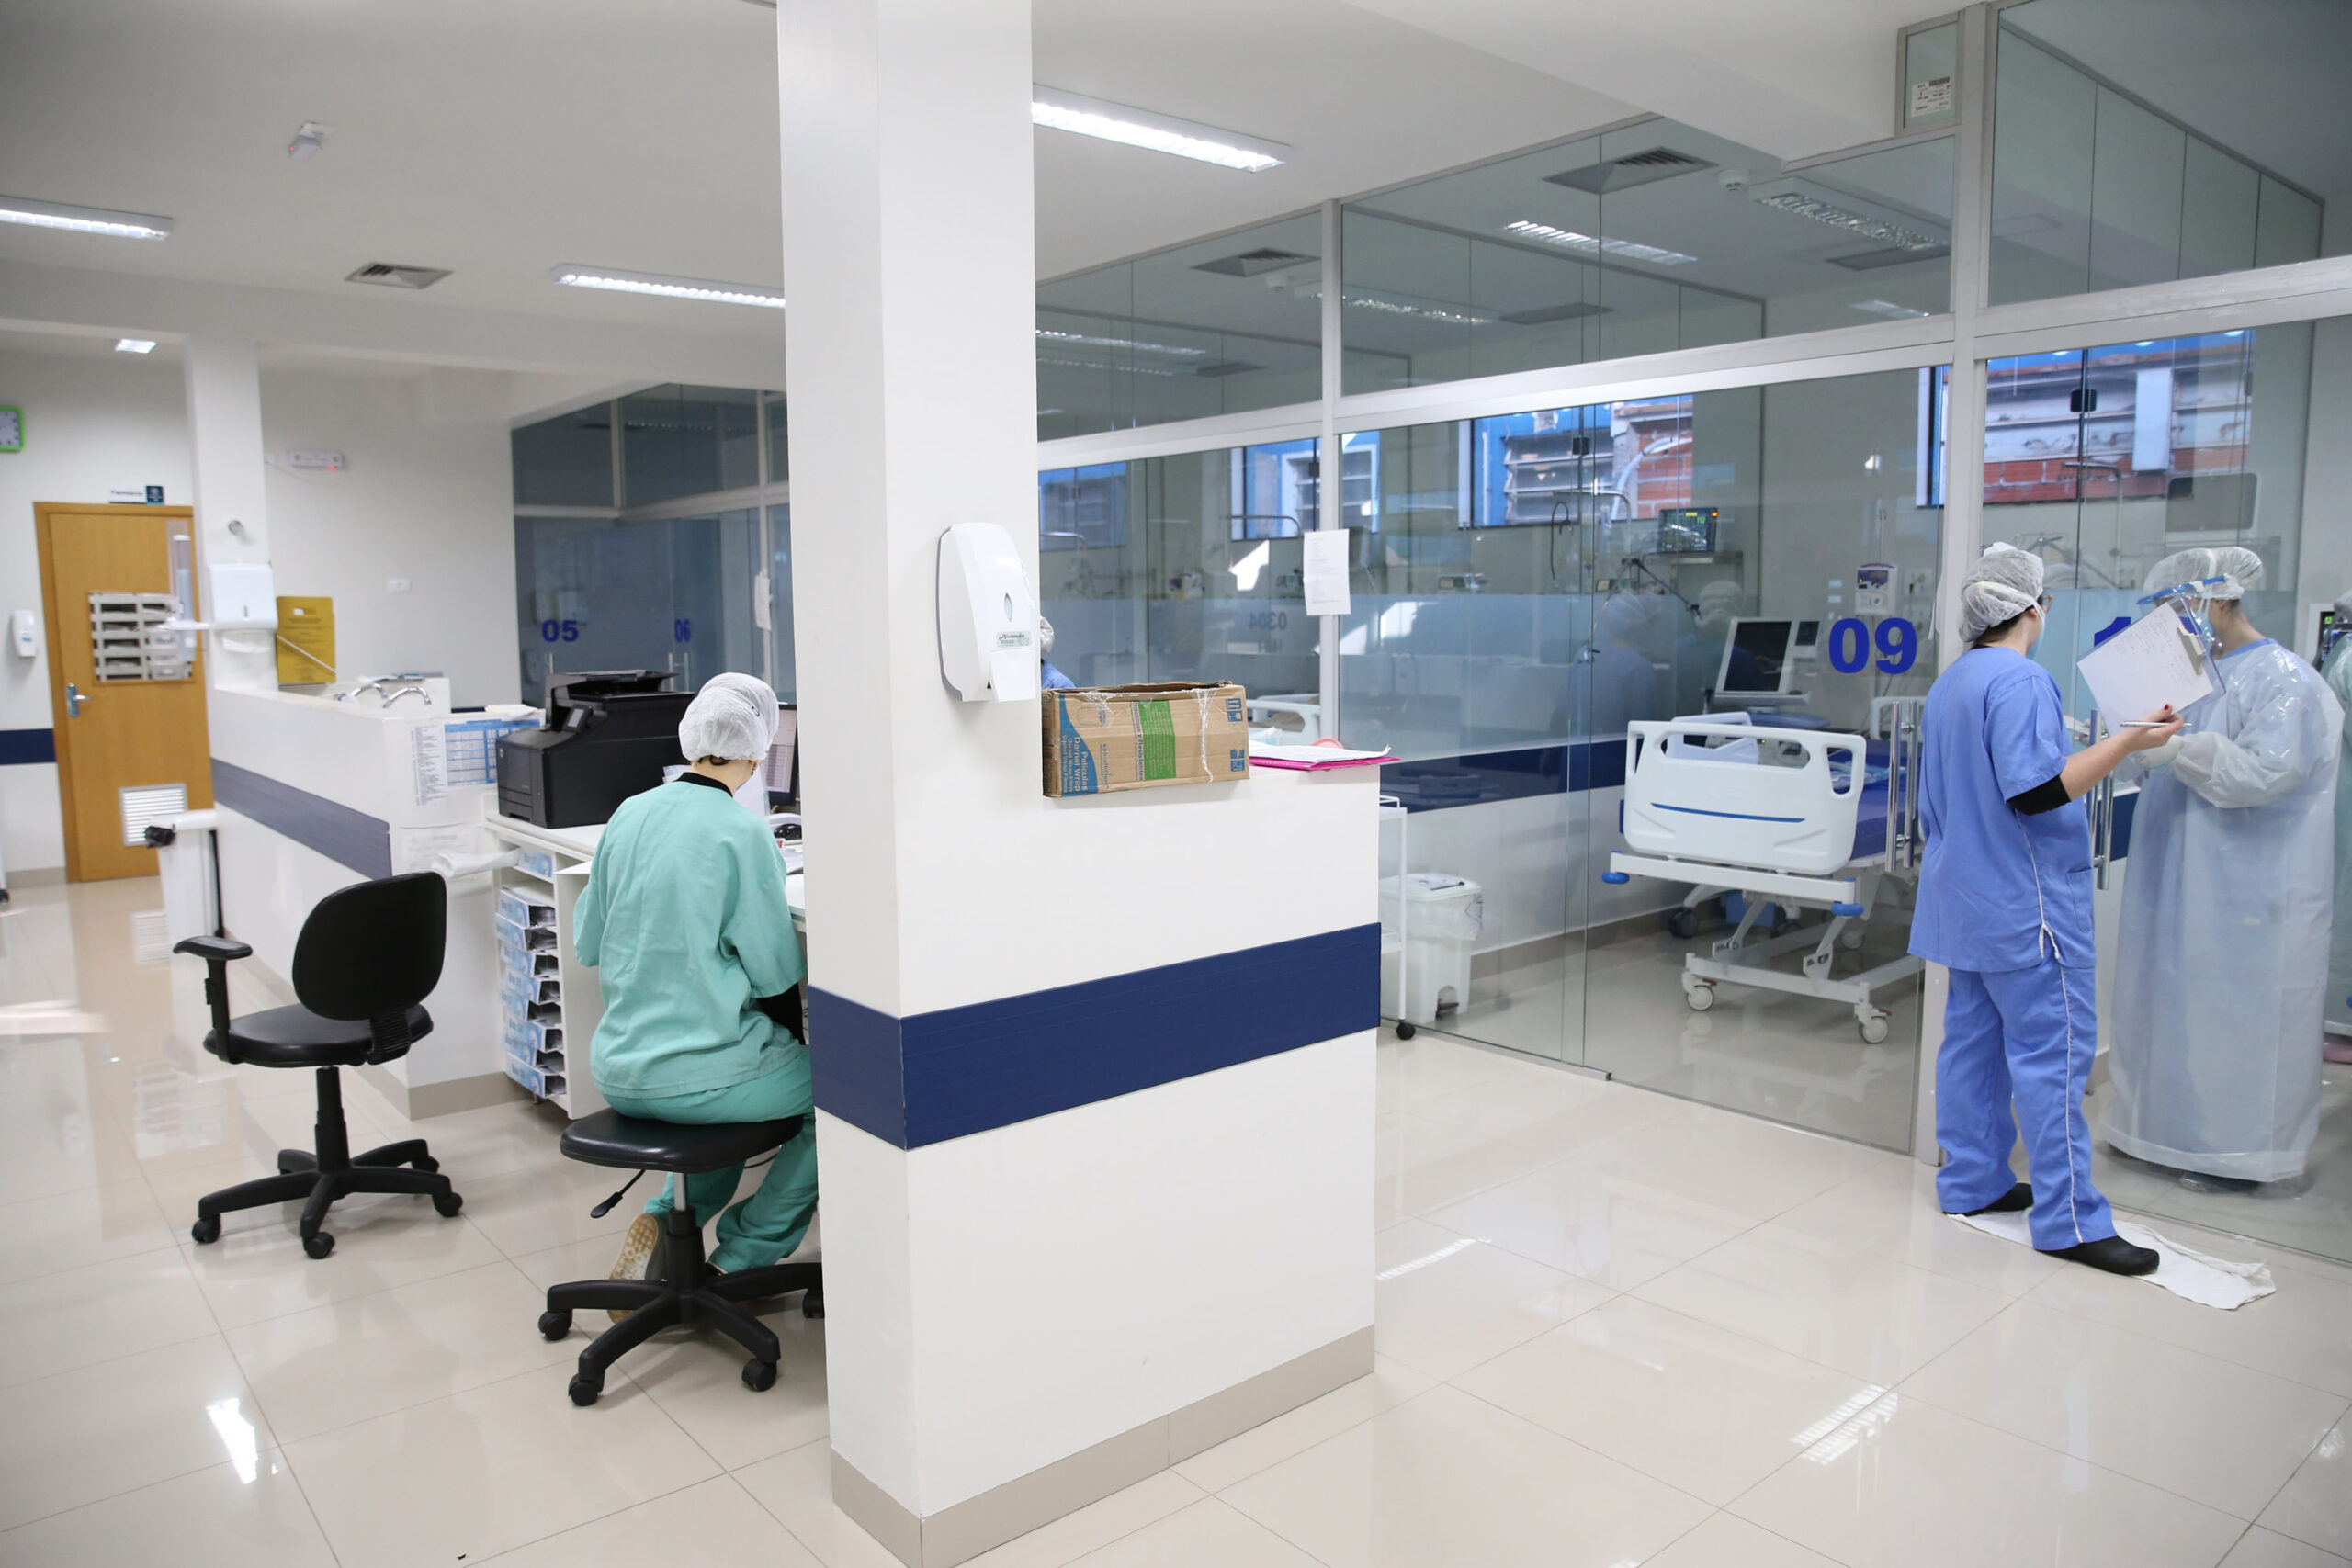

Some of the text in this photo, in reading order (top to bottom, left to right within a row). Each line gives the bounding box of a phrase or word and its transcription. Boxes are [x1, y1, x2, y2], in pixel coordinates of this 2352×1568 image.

[542, 619, 579, 642] 05
[674, 619, 691, 642] 06
[1829, 618, 1917, 675] 09
